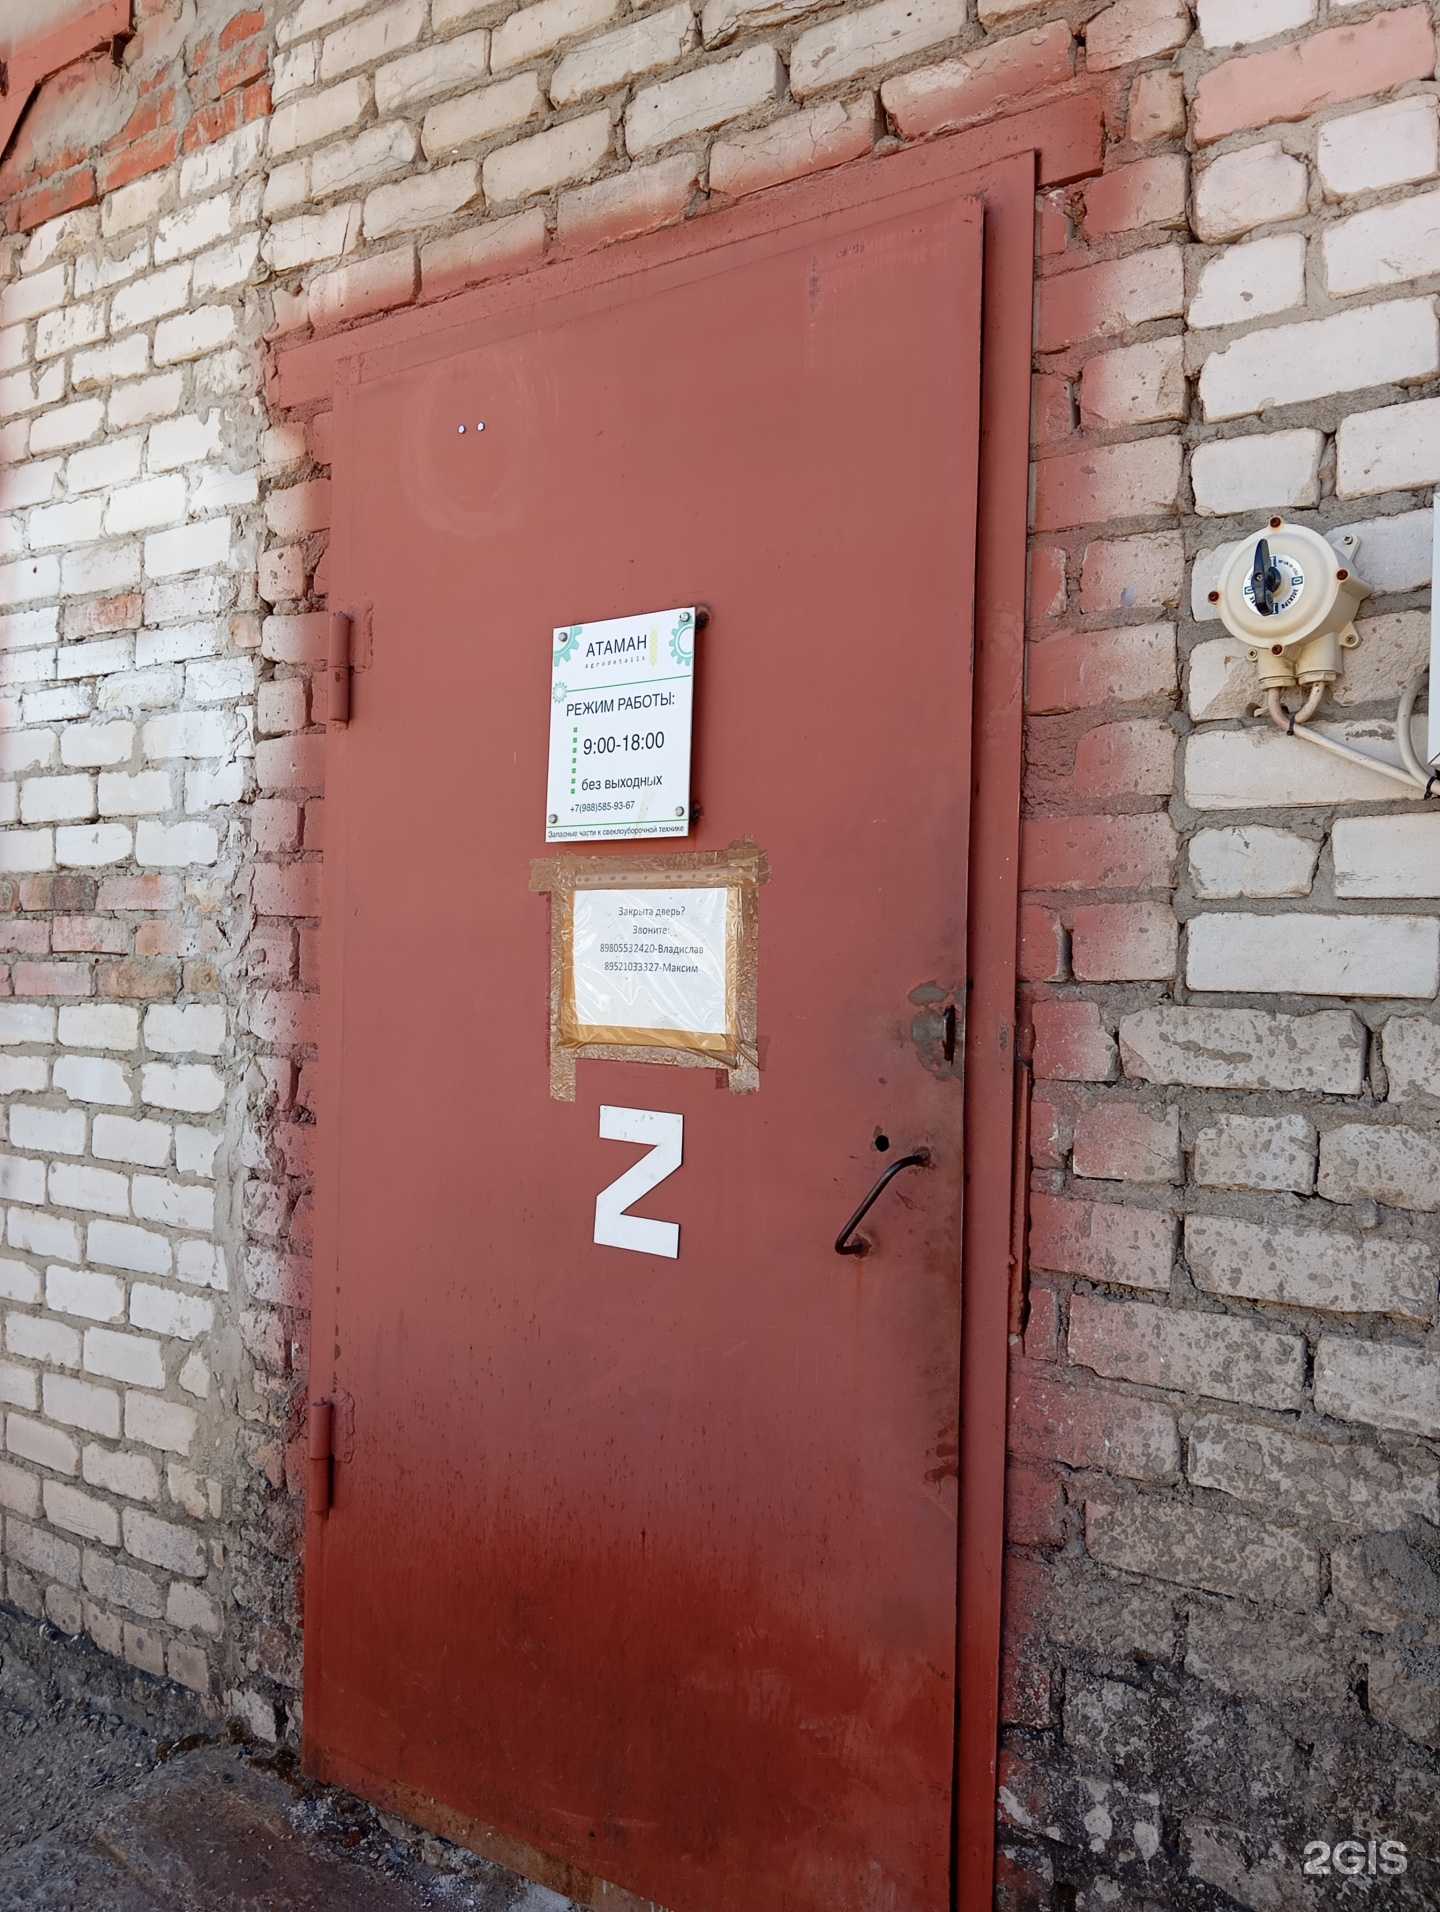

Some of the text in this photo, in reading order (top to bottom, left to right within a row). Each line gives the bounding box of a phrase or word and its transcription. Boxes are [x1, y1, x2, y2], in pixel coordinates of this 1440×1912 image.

[585, 634, 647, 657] АТАМАН
[566, 691, 675, 717] РЕЖИМ РАБОТЫ:
[583, 731, 665, 755] 9:00-18:00
[581, 775, 663, 791] без выходных
[547, 830, 578, 840] Запасные
[579, 829, 597, 838] части
[602, 825, 658, 838] свеклоуборочной
[658, 825, 685, 834] технике
[618, 906, 686, 918] Закрыта дверь?
[632, 925, 671, 935] Звоните:
